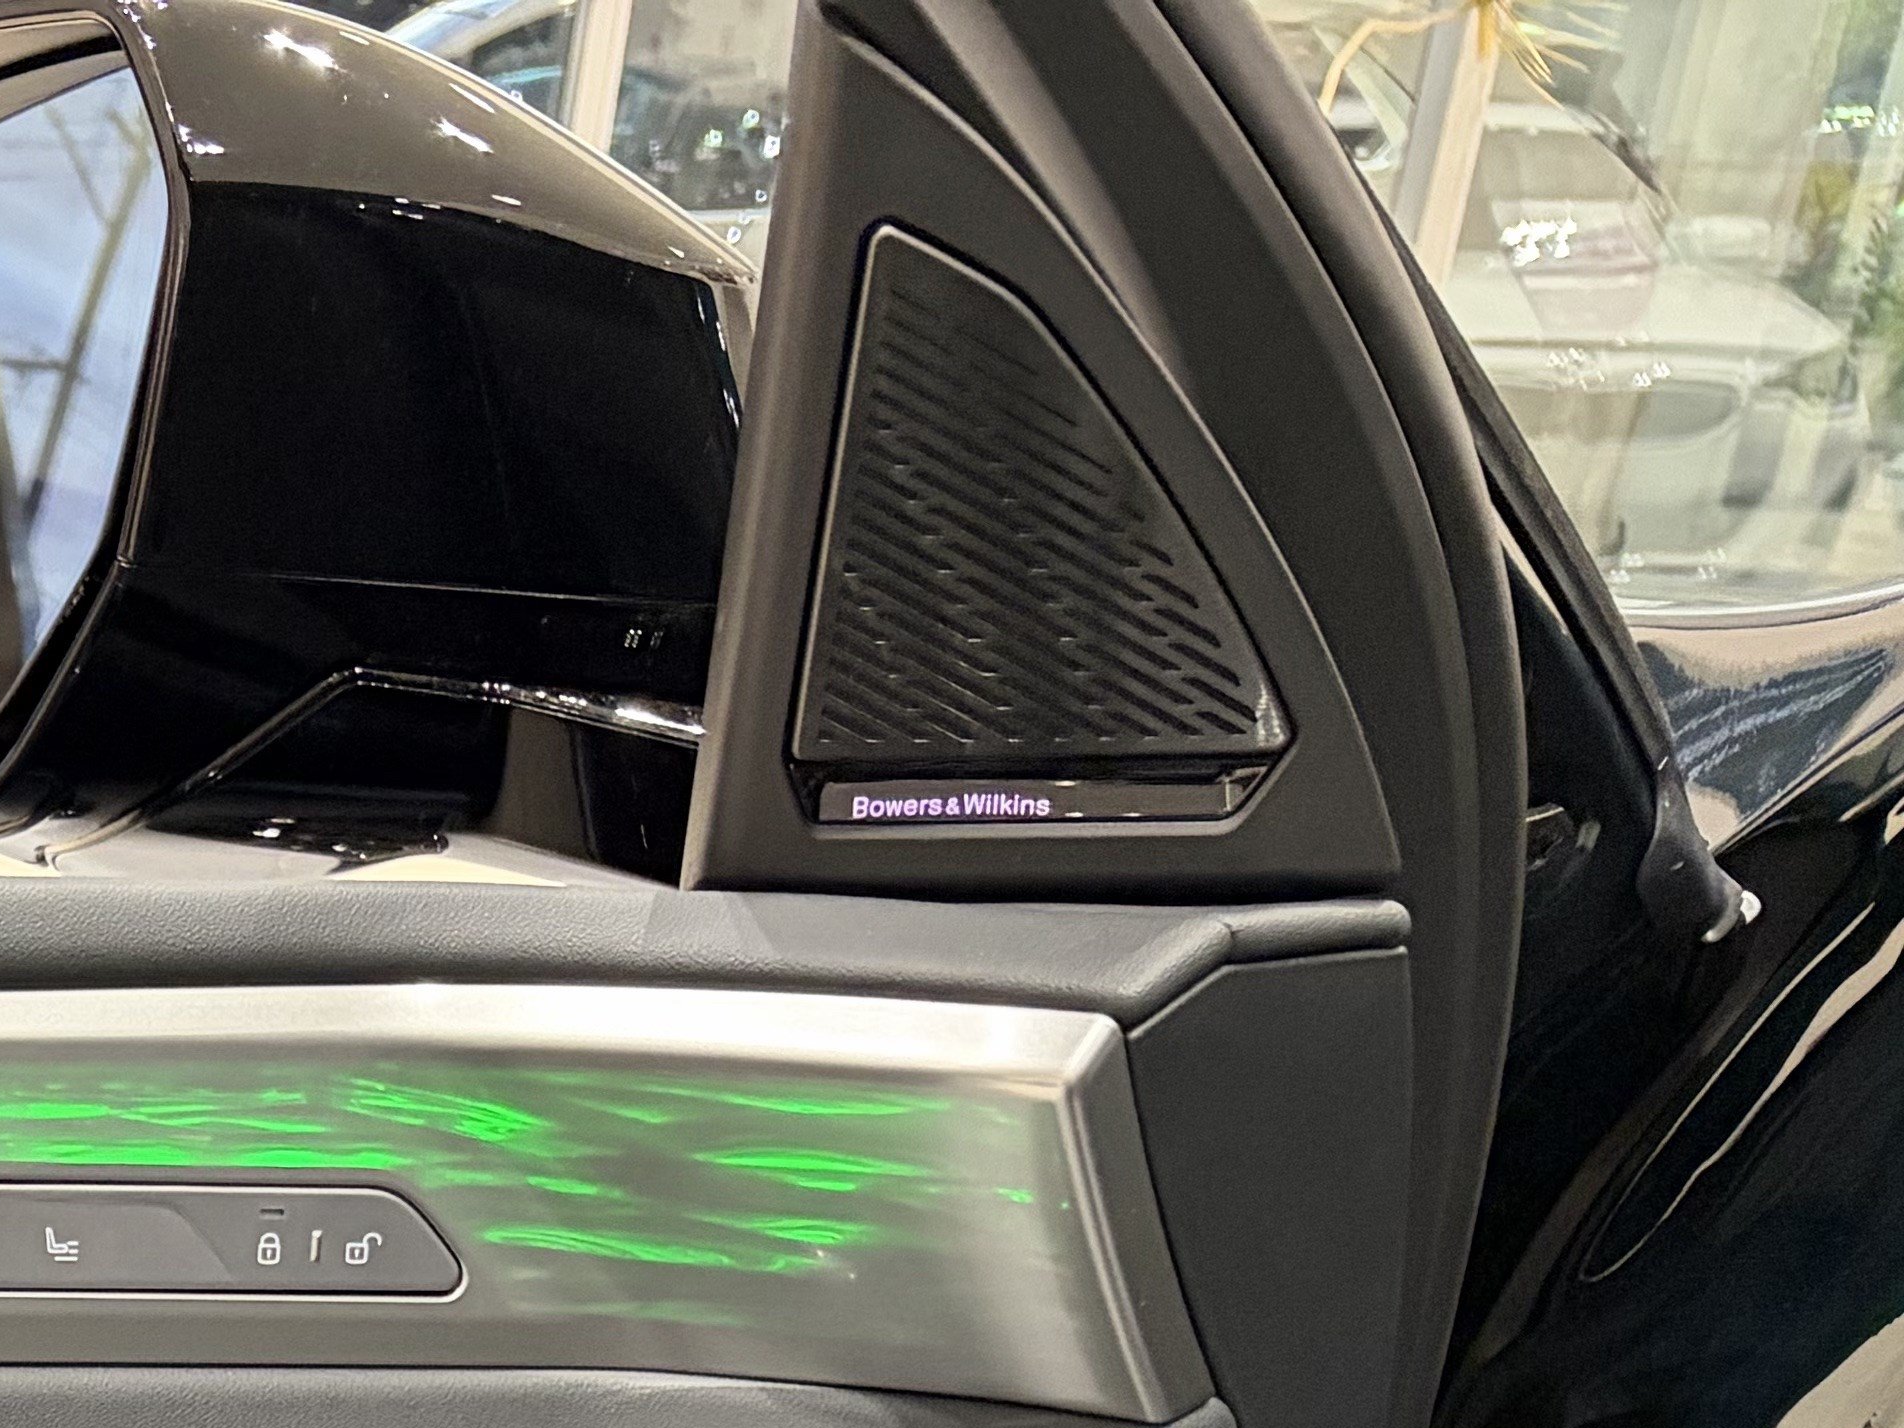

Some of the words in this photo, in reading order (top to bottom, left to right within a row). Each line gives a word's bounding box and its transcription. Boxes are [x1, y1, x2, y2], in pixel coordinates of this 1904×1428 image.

[852, 796, 942, 819] Bowers
[945, 797, 960, 816] &
[963, 793, 1050, 816] Wilkins
